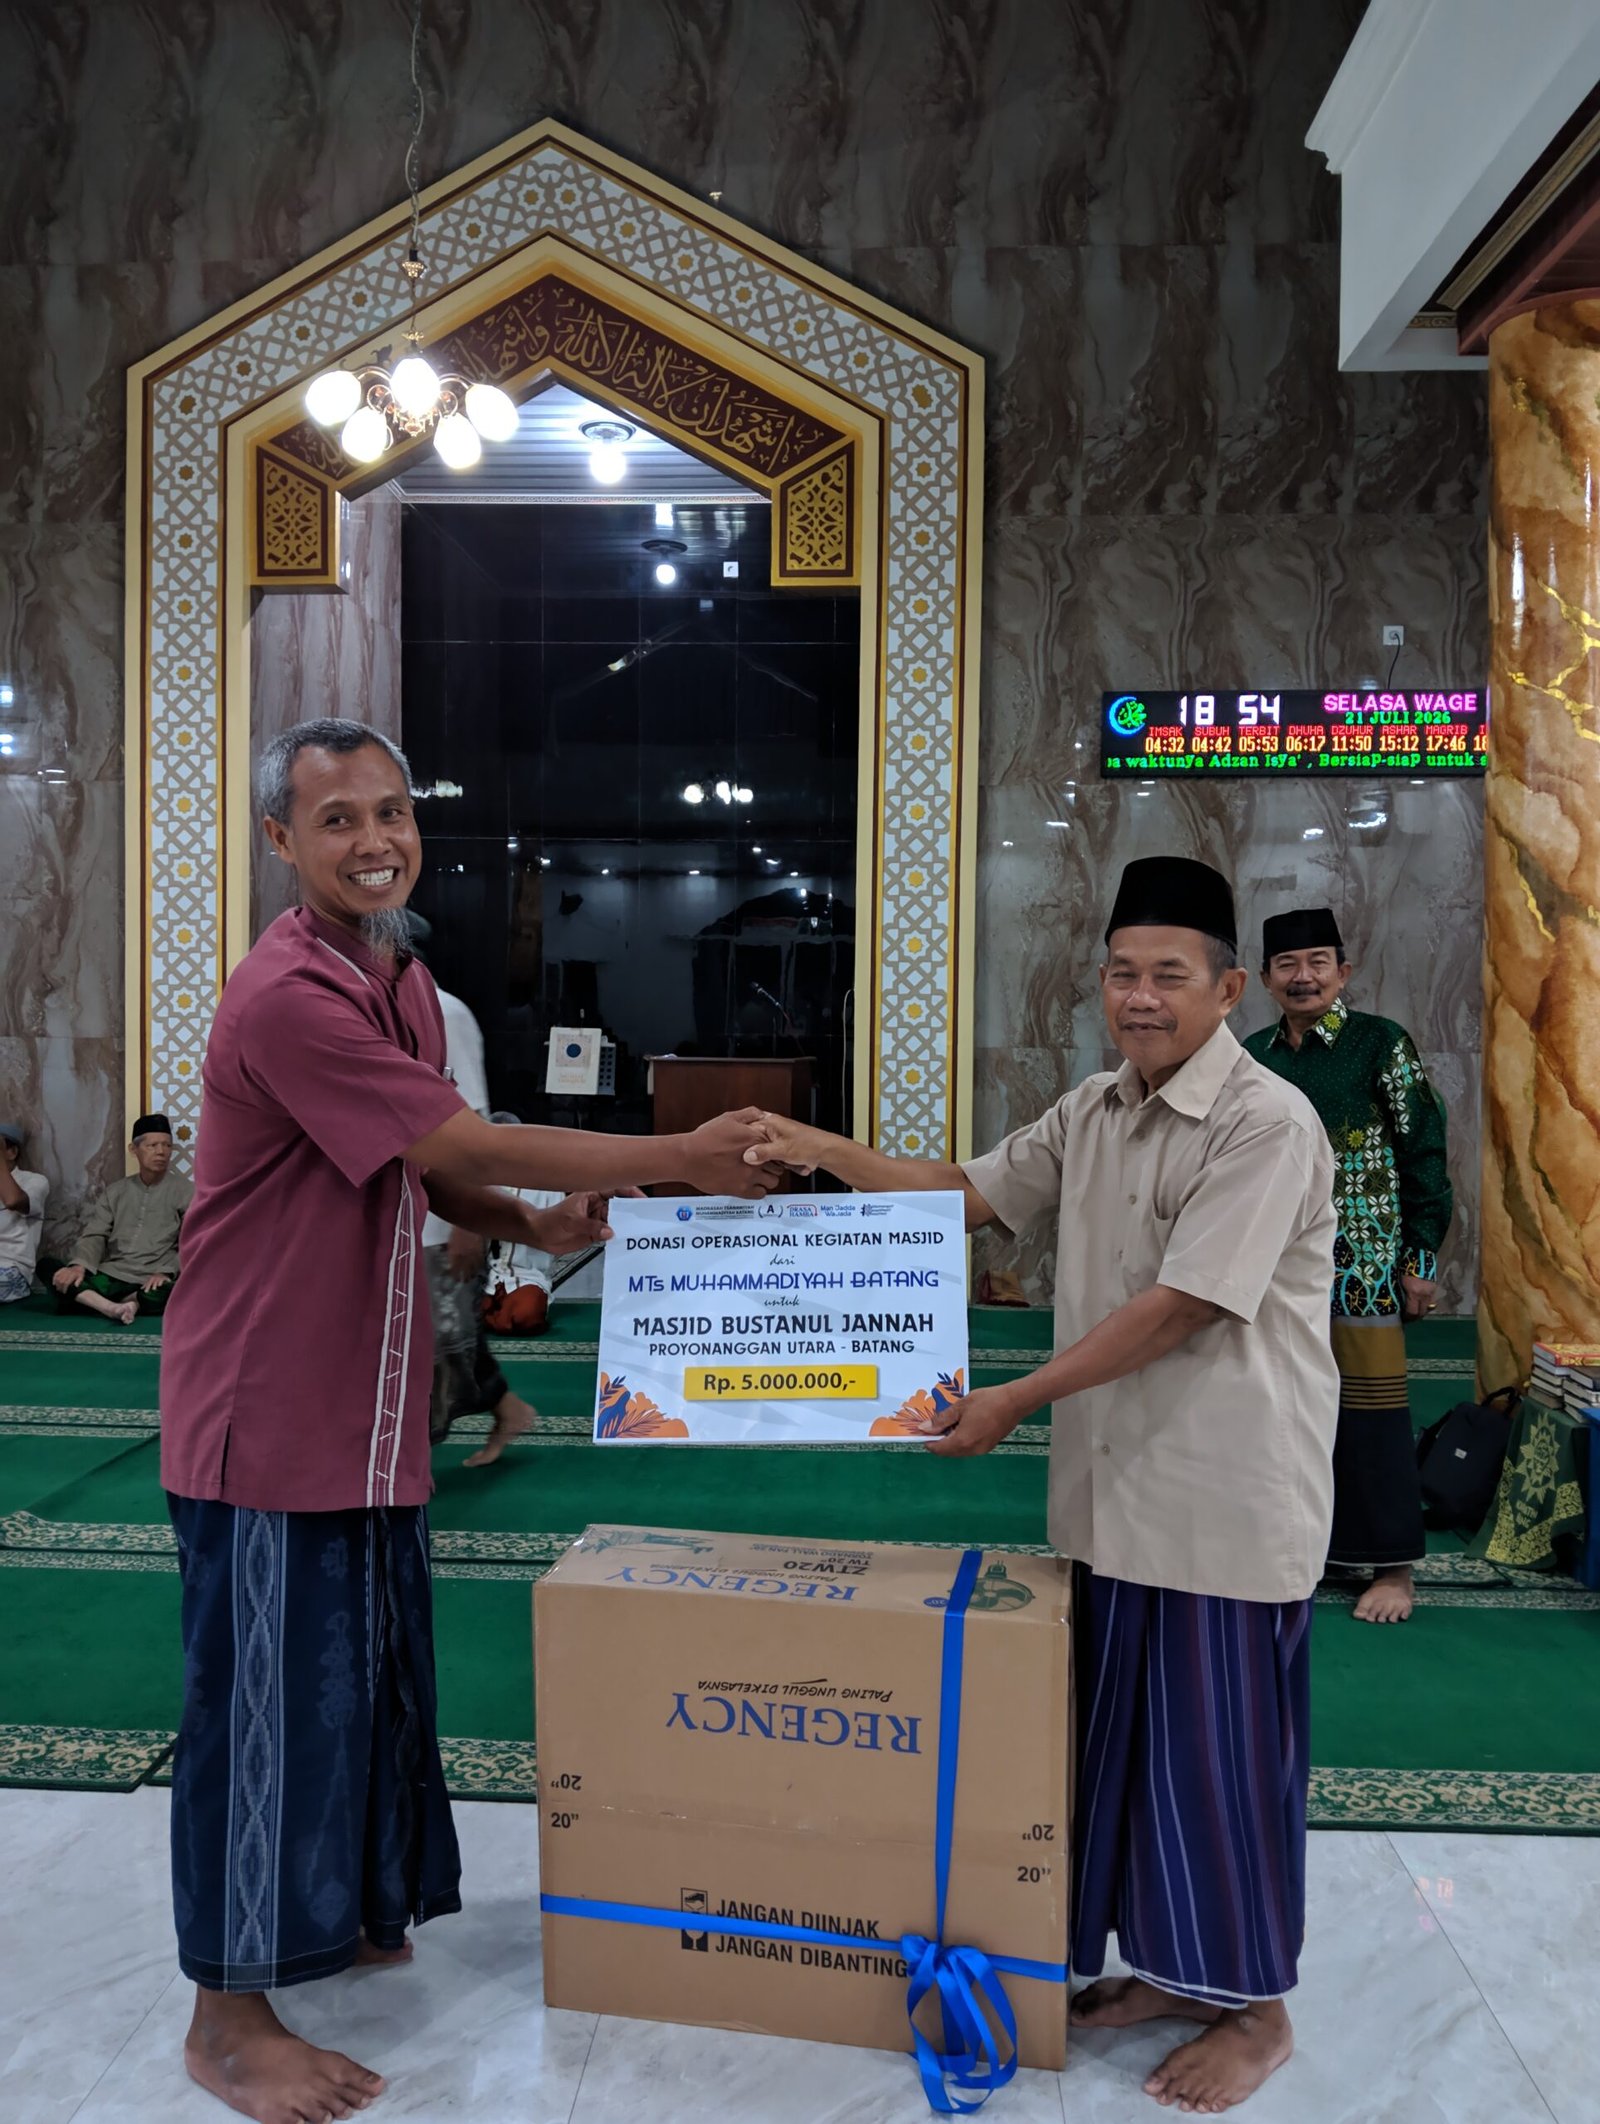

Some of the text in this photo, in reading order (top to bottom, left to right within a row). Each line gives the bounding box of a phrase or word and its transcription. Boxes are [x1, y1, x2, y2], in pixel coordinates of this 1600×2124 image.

[1179, 695, 1215, 726] 18
[1238, 695, 1280, 726] 54
[1324, 694, 1477, 712] SELASA WAGE
[1345, 711, 1451, 724] 21 JULI 2026
[1149, 727, 1183, 737] IMSAK
[1195, 727, 1230, 737] SUBUH
[1238, 726, 1281, 737] TERBIT
[1289, 726, 1324, 736] DHUHA
[1332, 725, 1374, 736] DZUHUR
[1382, 725, 1418, 736] ASHAR
[1426, 725, 1468, 736] MAGRIB
[1145, 736, 1185, 753] 04:32
[1192, 736, 1232, 753] 04:42
[1238, 736, 1279, 752] 05:53
[1285, 736, 1326, 752] 06:17
[1332, 735, 1372, 752] 11:50
[1379, 735, 1419, 752] 15:12
[1426, 735, 1467, 752] 17:46
[1209, 754, 1259, 768] Adzan
[1427, 753, 1475, 767] untuk
[766, 1204, 775, 1214] A
[626, 1231, 944, 1251] DONASI OPERASIONAL KEGIATAN MASJID
[769, 1253, 796, 1266] dari
[628, 1270, 939, 1292] MTs MUHAMMADIYAH BATANG
[763, 1296, 800, 1308] untuk
[633, 1313, 934, 1336] MASJID BUSTANUL JANNAH
[649, 1342, 781, 1356] PROYONANGGAN
[788, 1341, 835, 1355] UTARA
[852, 1340, 915, 1353] BATANG
[704, 1372, 856, 1394] Rp. 5.000.000,-
[783, 1560, 870, 1577] ZTW20
[848, 1558, 871, 1566] TW
[604, 1566, 859, 1601] REGENCY
[698, 1680, 893, 1703] PALING UNGGUL DIKELASNYA
[666, 1692, 922, 1754] REGENCY
[716, 1899, 880, 1939] JANGAN DIINJAK
[715, 1935, 908, 1978] JANGAN DIBANTING
